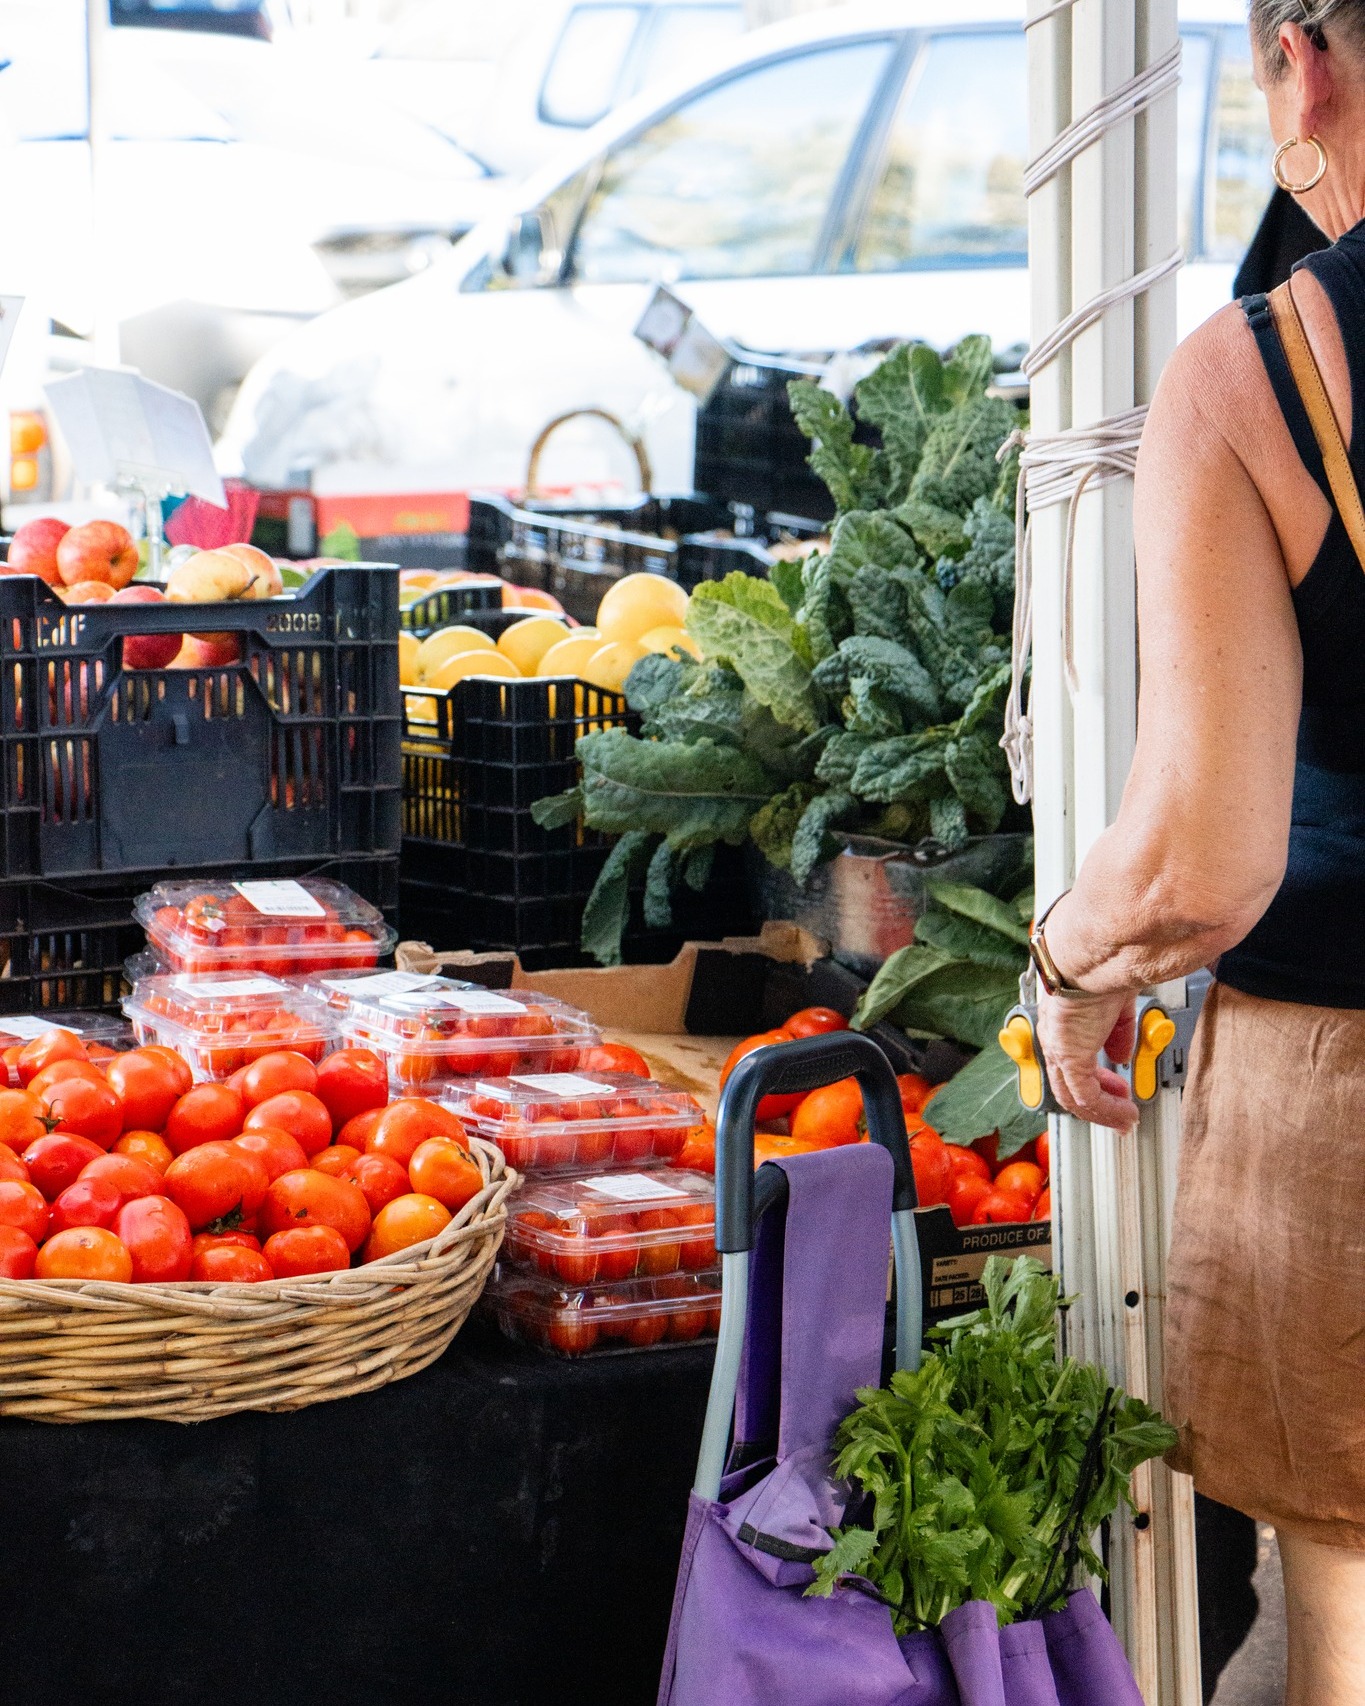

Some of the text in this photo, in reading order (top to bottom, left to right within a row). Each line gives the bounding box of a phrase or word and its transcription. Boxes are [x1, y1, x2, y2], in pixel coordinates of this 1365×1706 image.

[266, 612, 321, 632] 2008
[963, 1229, 1023, 1249] PRODUCE
[1027, 1227, 1045, 1241] OF
